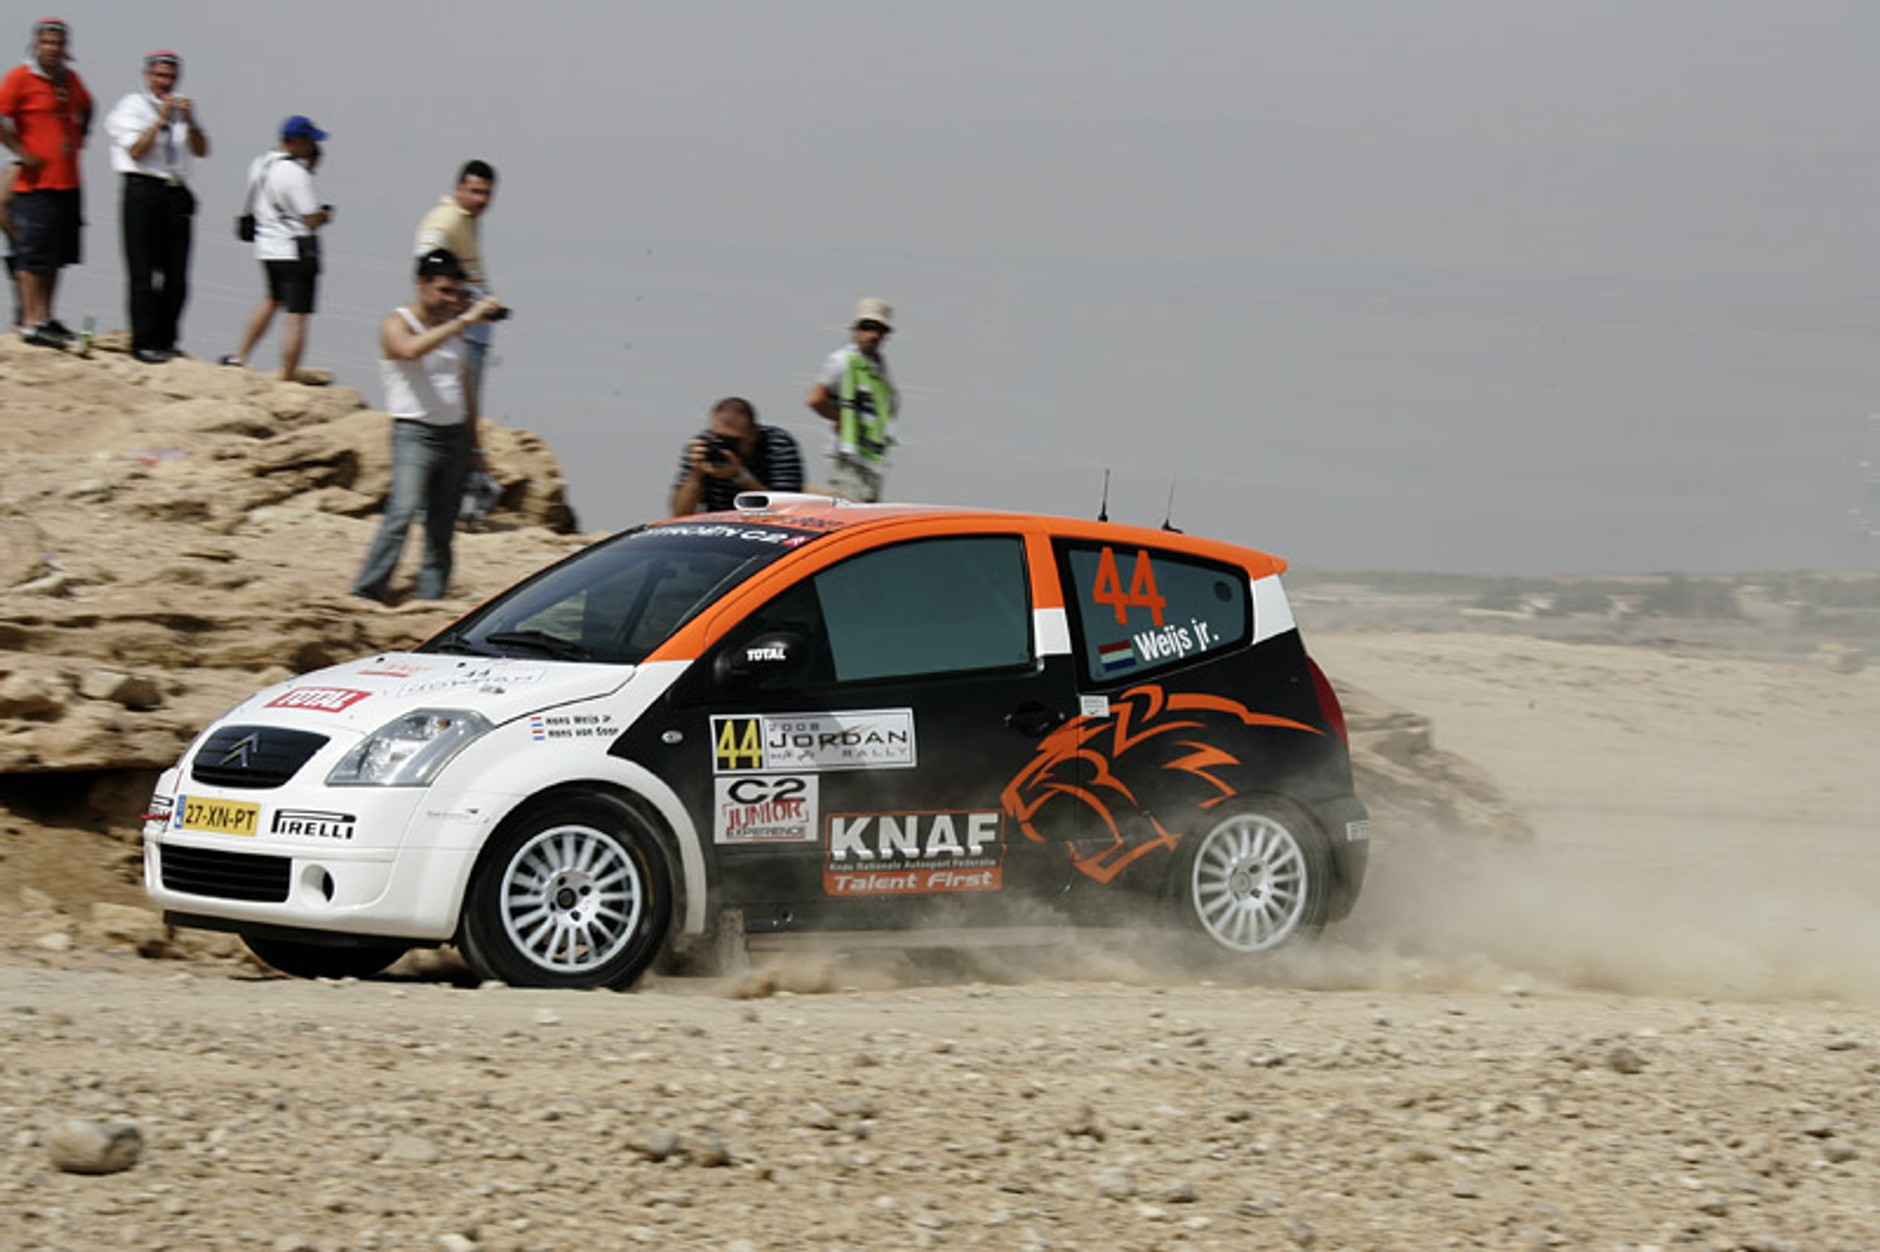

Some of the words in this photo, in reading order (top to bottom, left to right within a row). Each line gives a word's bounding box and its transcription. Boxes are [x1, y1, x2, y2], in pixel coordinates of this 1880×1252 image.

[1092, 546, 1167, 627] 44
[1133, 624, 1193, 661] Weijs
[1191, 617, 1219, 652] jr.
[747, 648, 786, 661] TOTAL
[769, 723, 820, 732] 2008
[769, 730, 907, 751] JORDAN
[717, 719, 762, 769] 44
[841, 748, 907, 759] RALLY
[728, 778, 807, 804] C2
[185, 804, 257, 831] 27-XN-PT
[271, 808, 357, 840] PIRELLI
[727, 799, 802, 832] JUNIOR
[831, 813, 998, 861] KNAF
[834, 874, 918, 891] Talent
[926, 871, 993, 888] First
